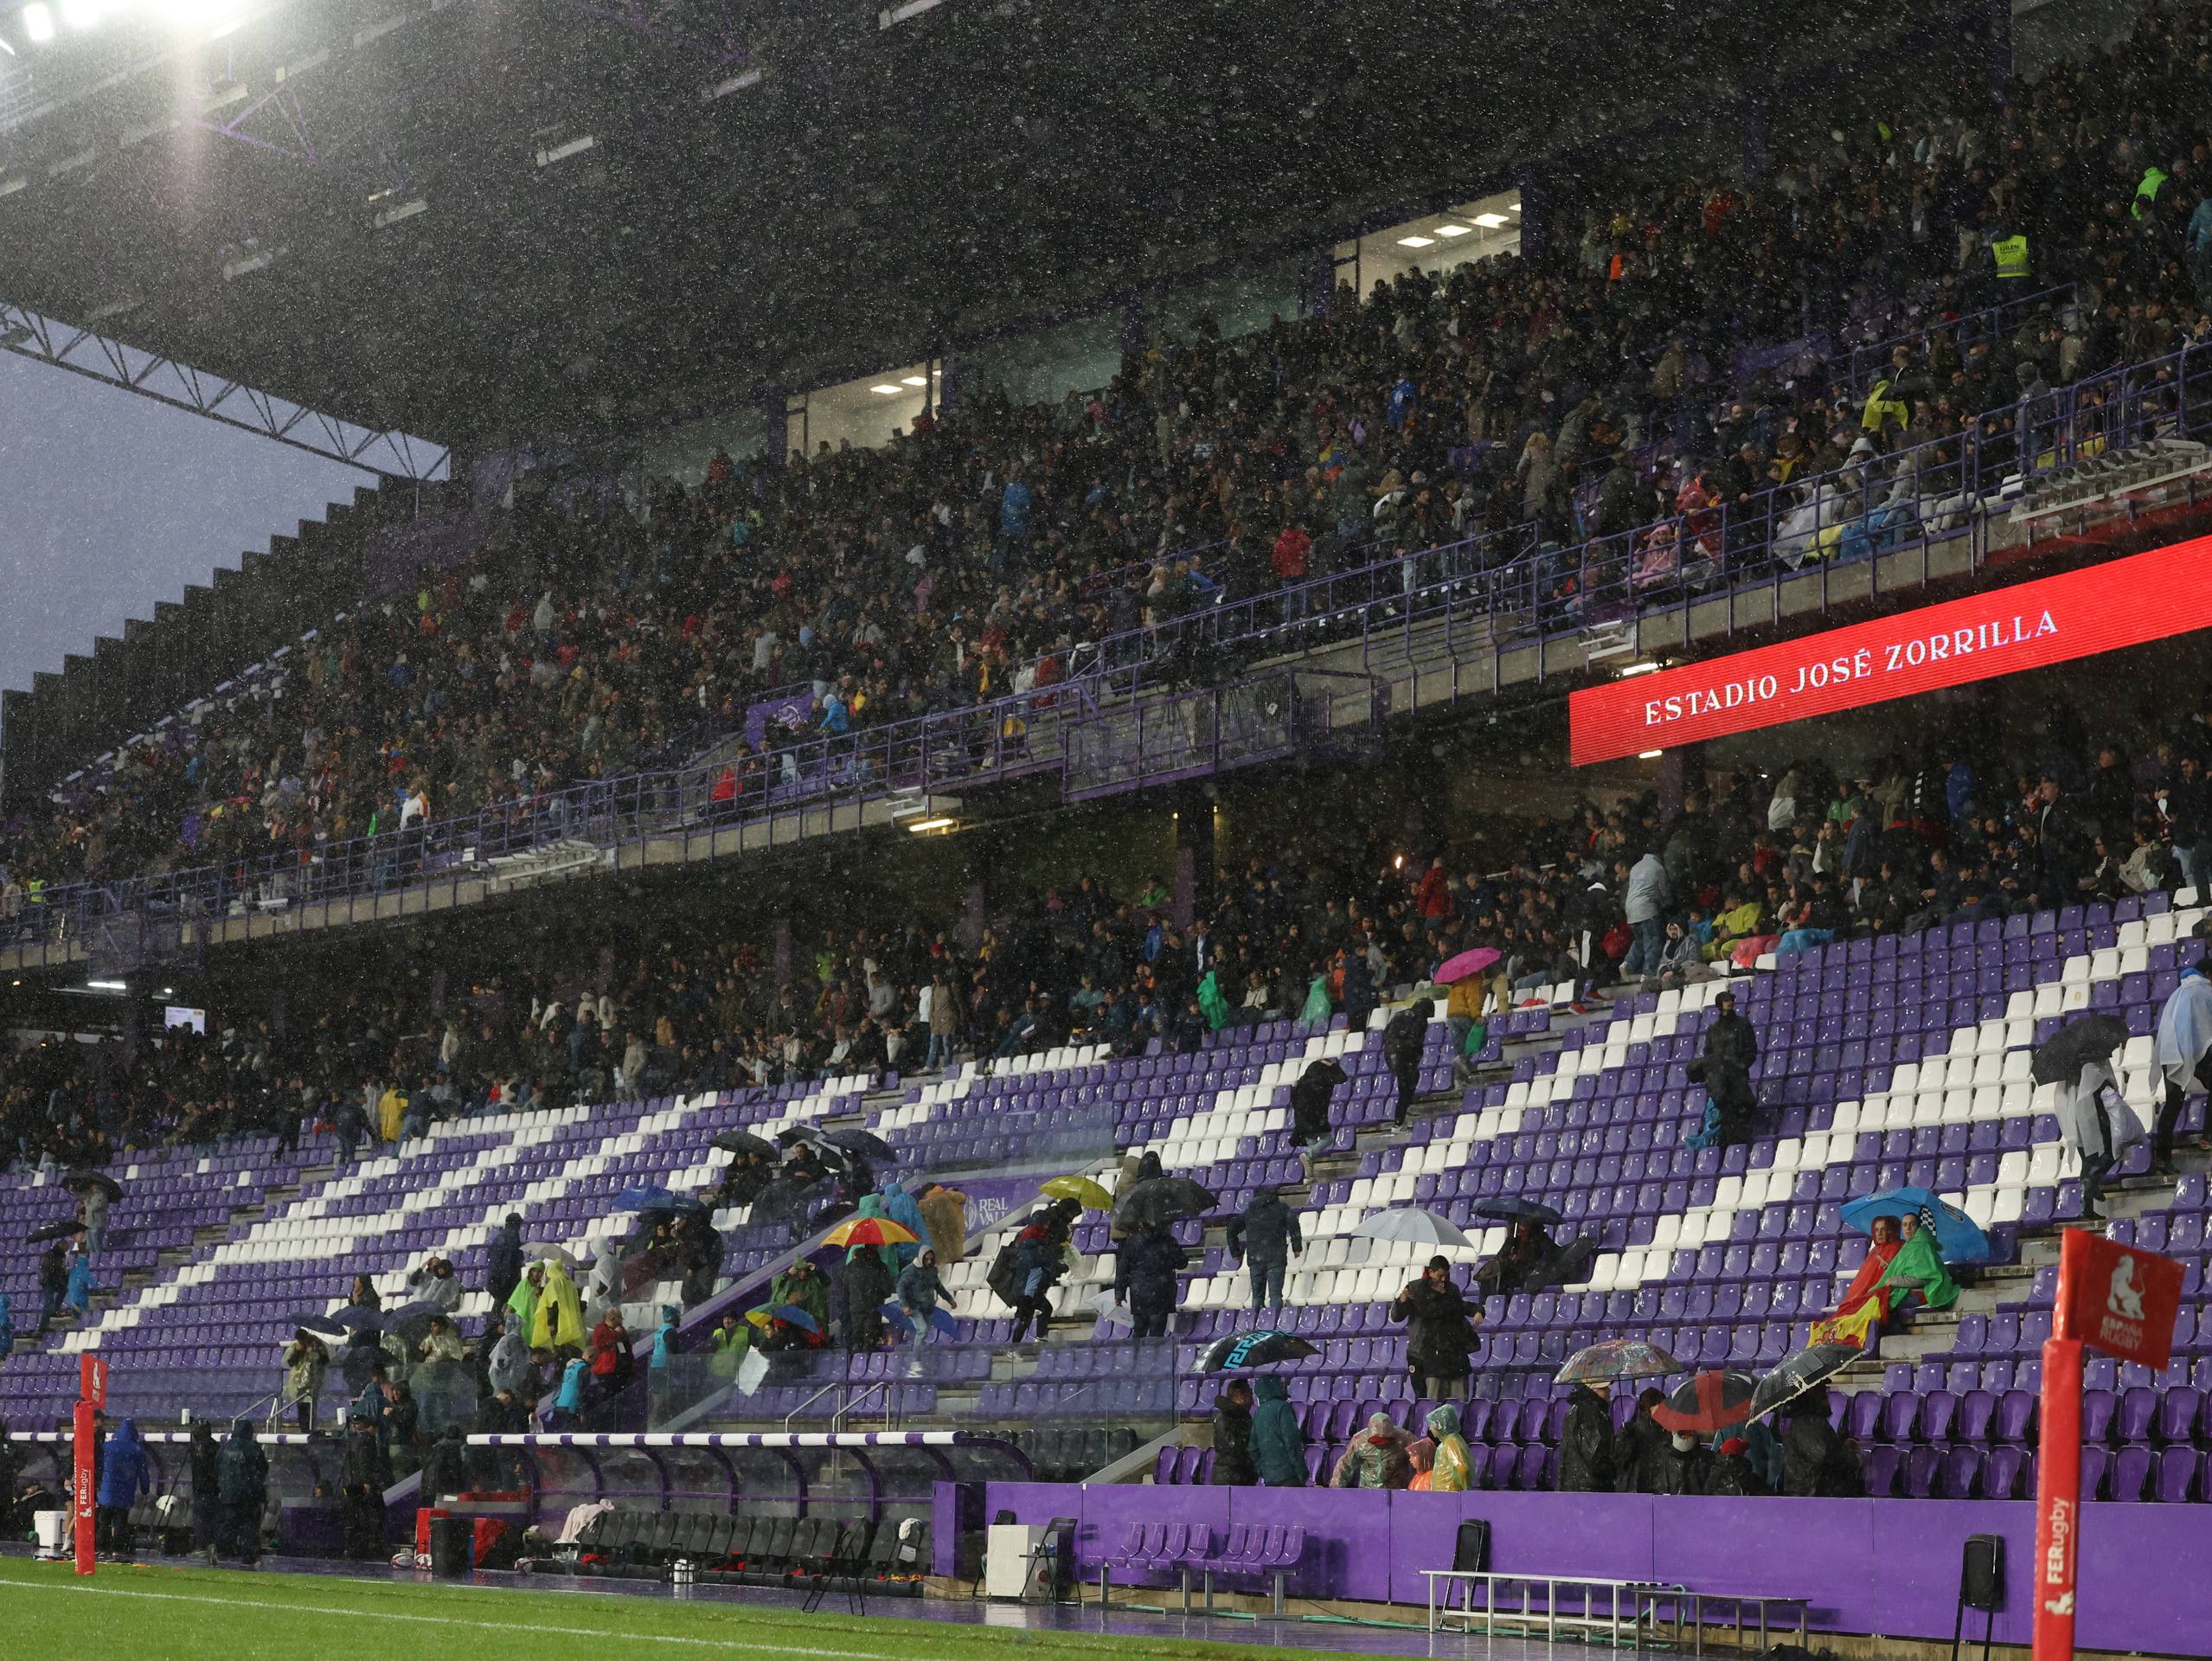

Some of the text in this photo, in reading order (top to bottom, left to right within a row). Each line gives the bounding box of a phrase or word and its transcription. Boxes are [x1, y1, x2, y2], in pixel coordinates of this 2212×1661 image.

[1645, 609, 2059, 726] ESTADIO JOSÉ ZORRILLA
[978, 1197, 1009, 1212] REAL
[2100, 1327, 2144, 1351] RUGBY
[80, 1468, 89, 1505] FERugby
[2047, 1497, 2070, 1585] FERugby
